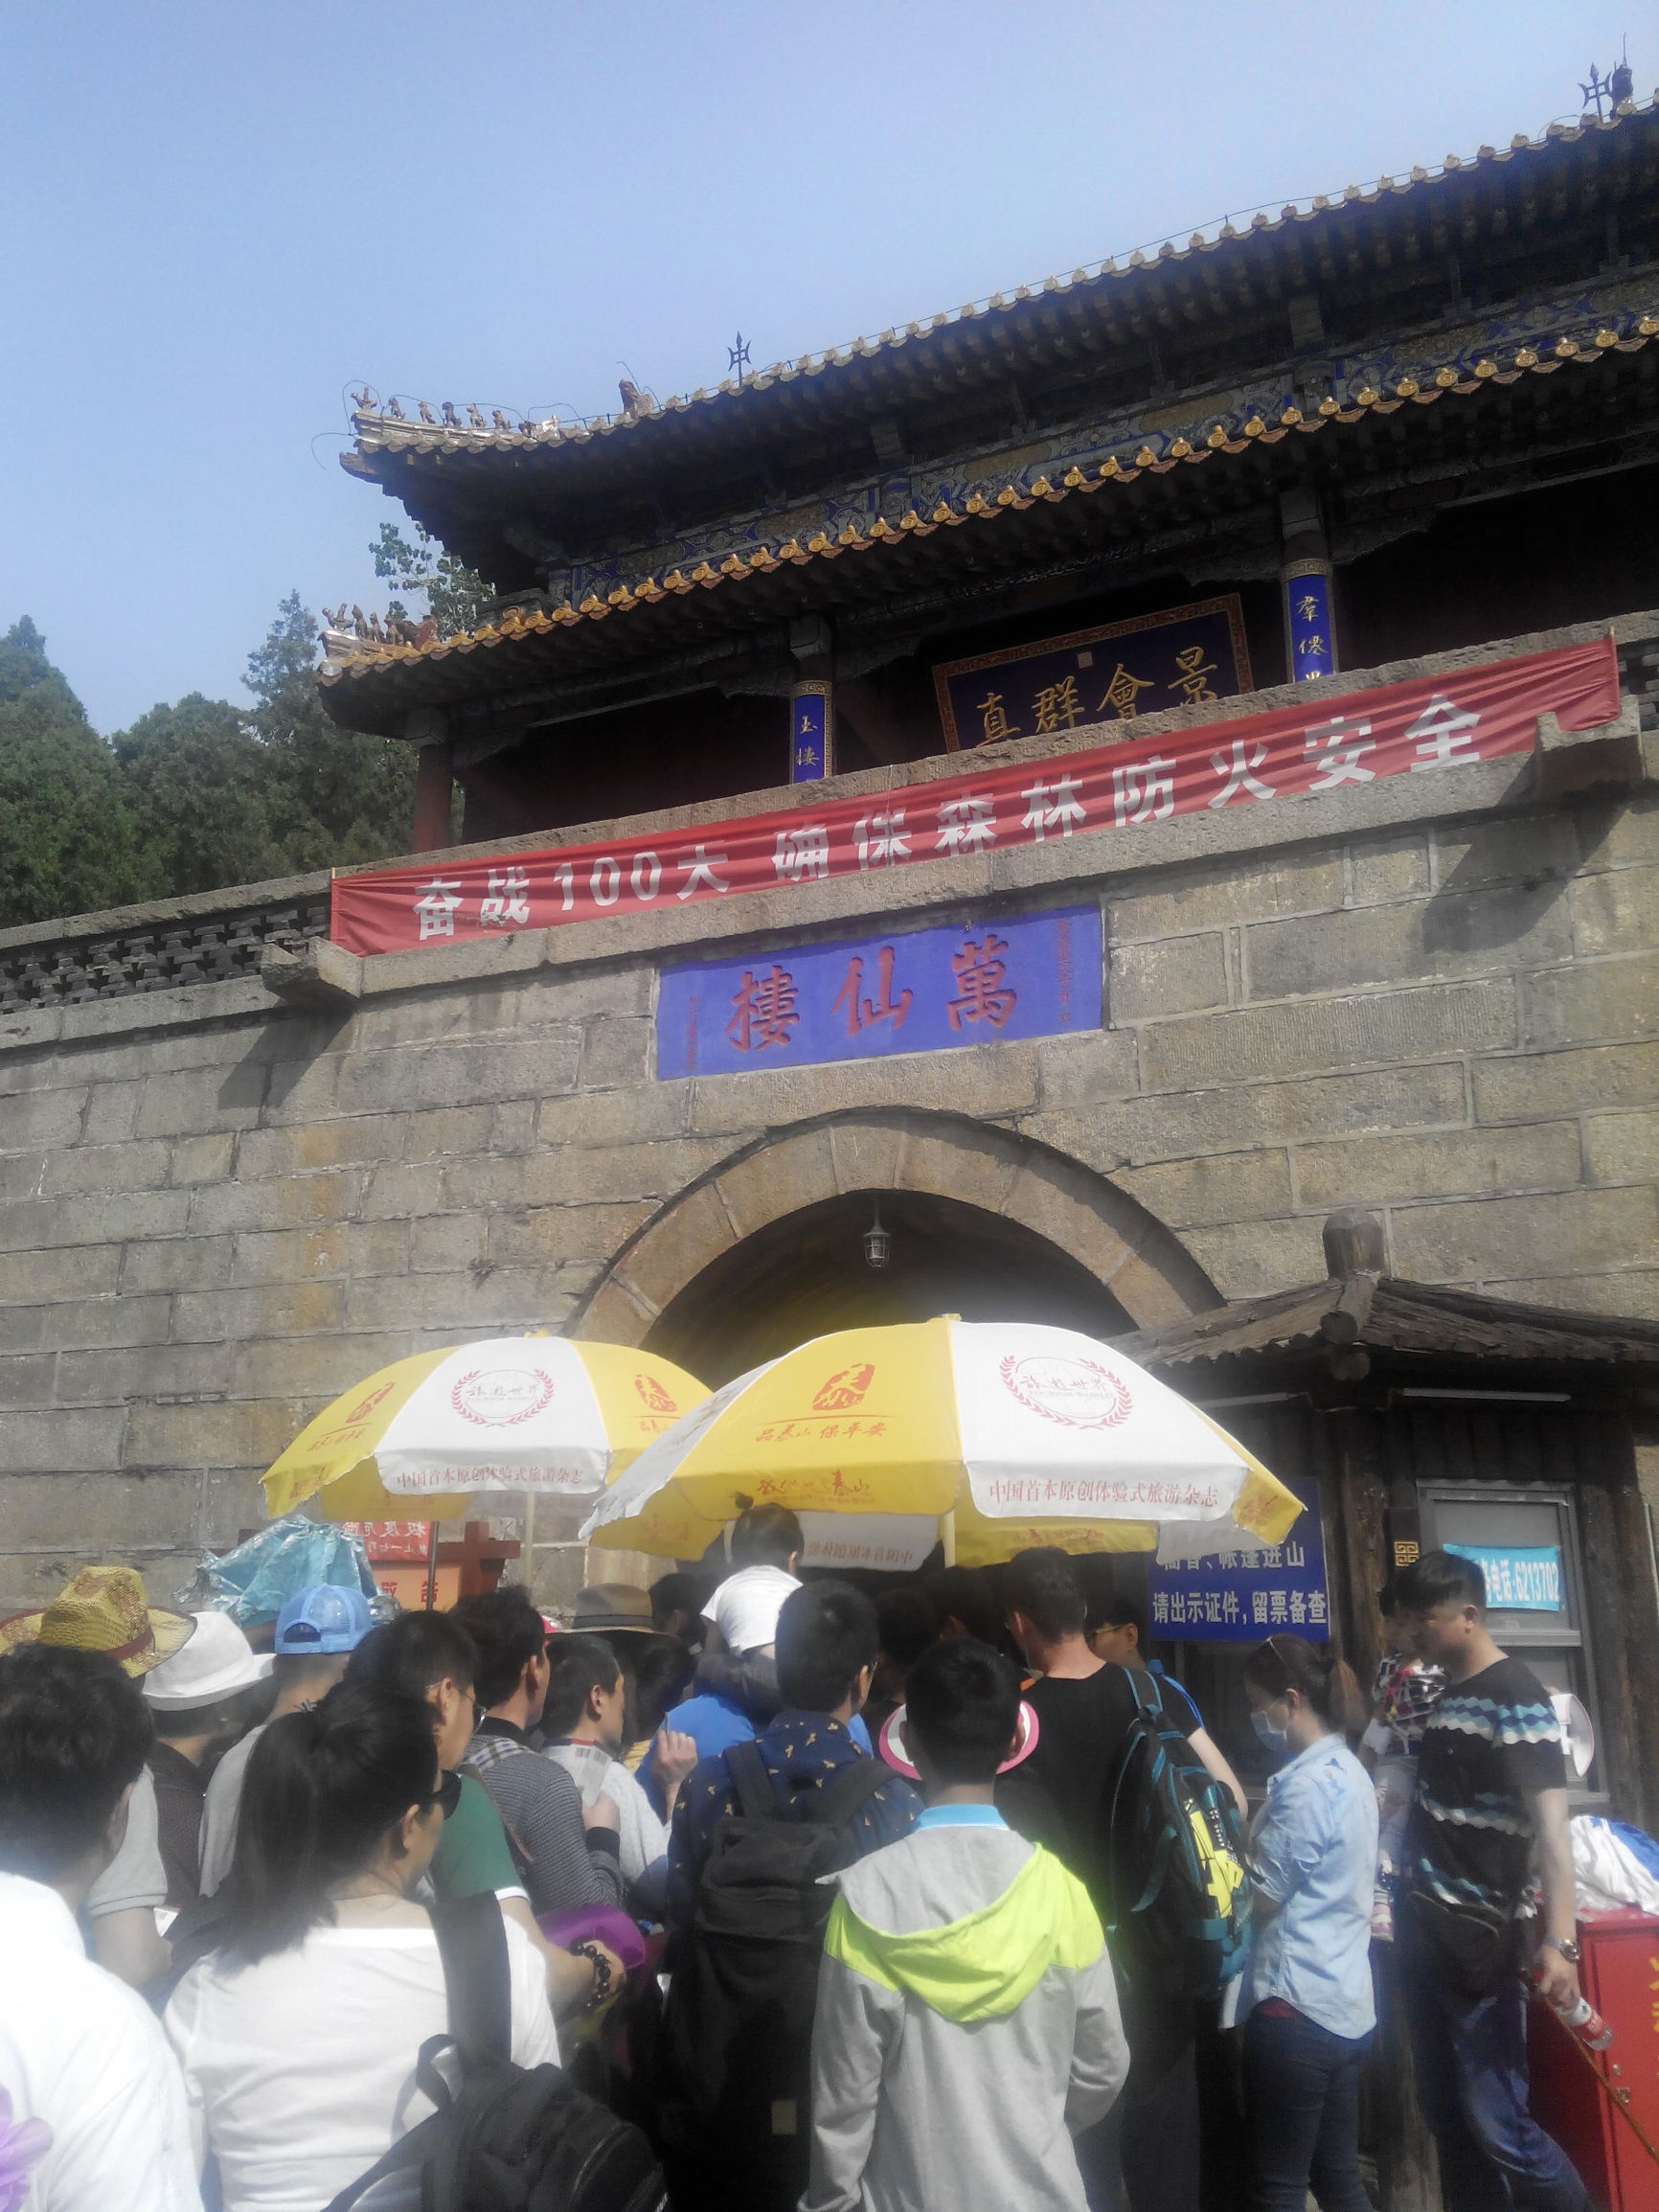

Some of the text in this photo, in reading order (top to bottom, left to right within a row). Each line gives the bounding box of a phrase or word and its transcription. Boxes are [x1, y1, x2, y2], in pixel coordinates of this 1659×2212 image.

[989, 1479, 1218, 1507] 中国首本原创体验式旅游杂志
